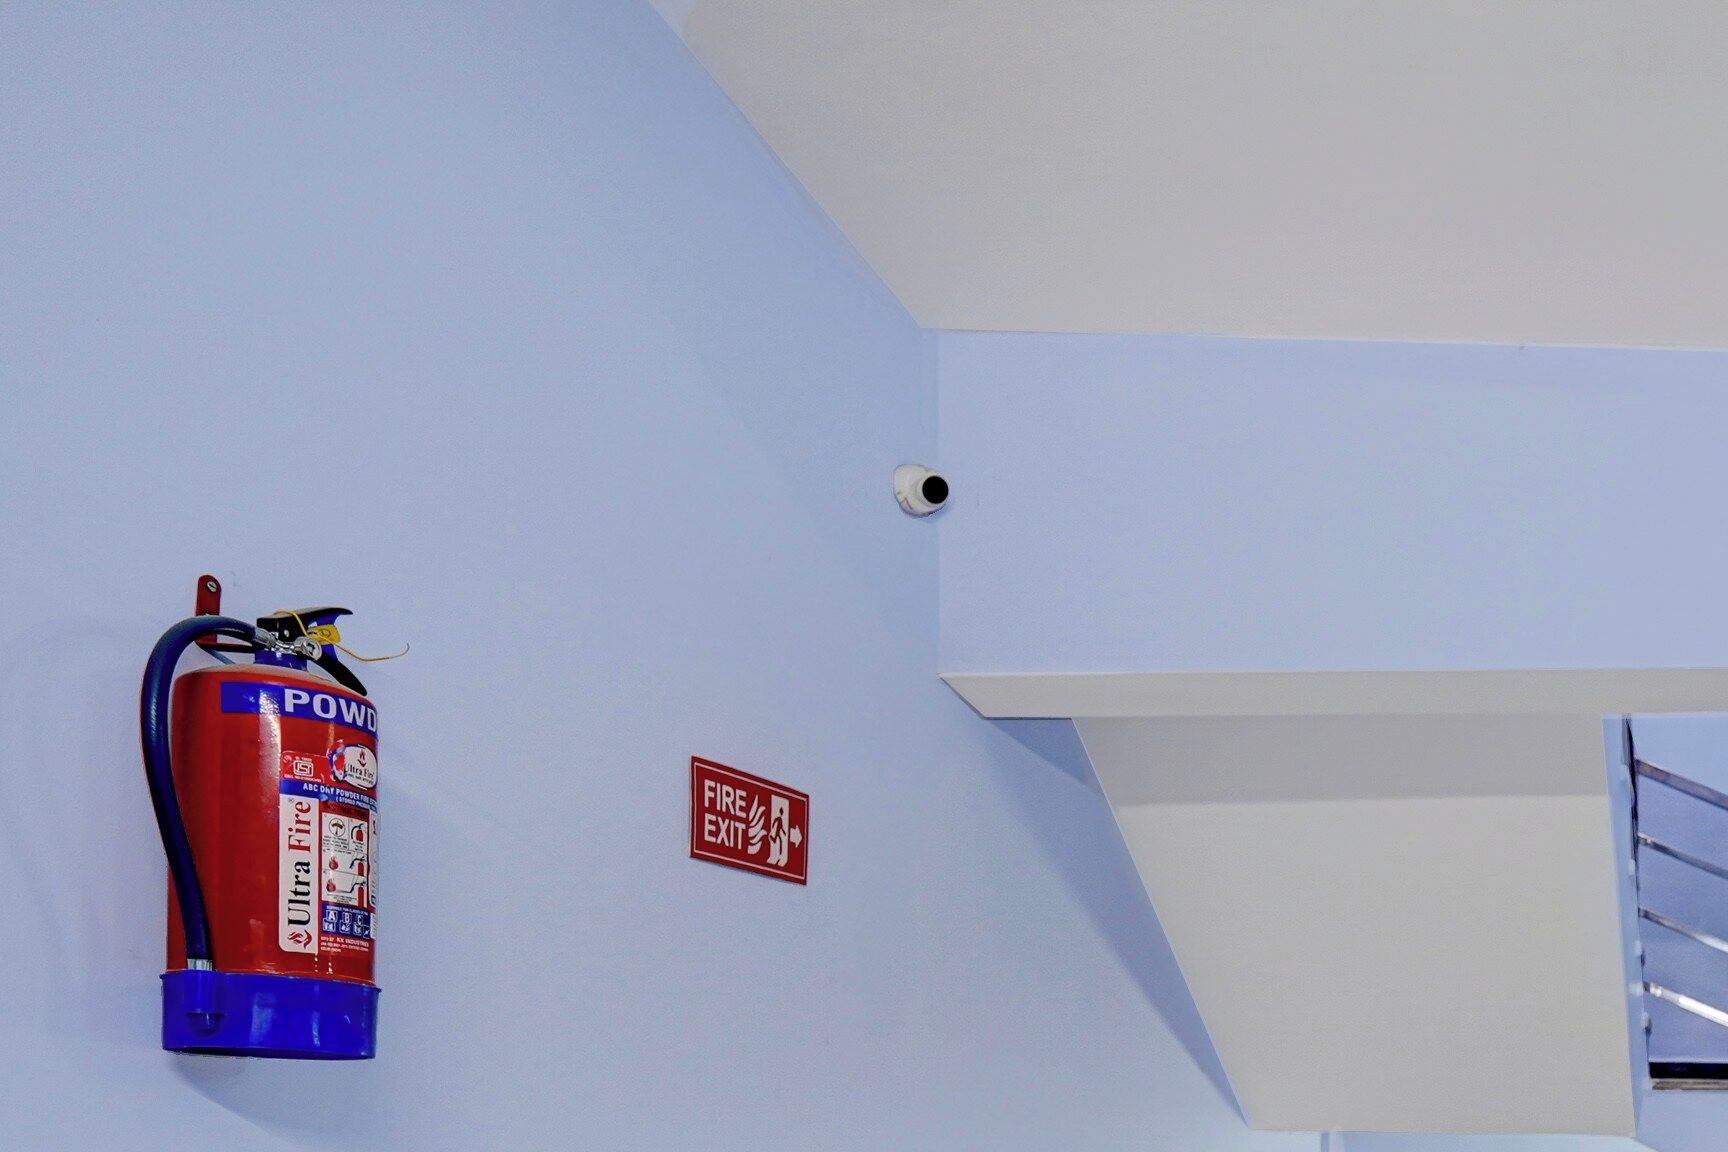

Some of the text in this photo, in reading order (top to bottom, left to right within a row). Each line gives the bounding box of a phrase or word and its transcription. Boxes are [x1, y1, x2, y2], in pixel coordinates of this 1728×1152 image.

[303, 783, 318, 792] ABC
[336, 789, 360, 801] POWDER
[704, 779, 747, 818] FIRE
[288, 801, 311, 852] Fire
[704, 813, 746, 850] EXIT
[288, 861, 311, 926] Ultra
